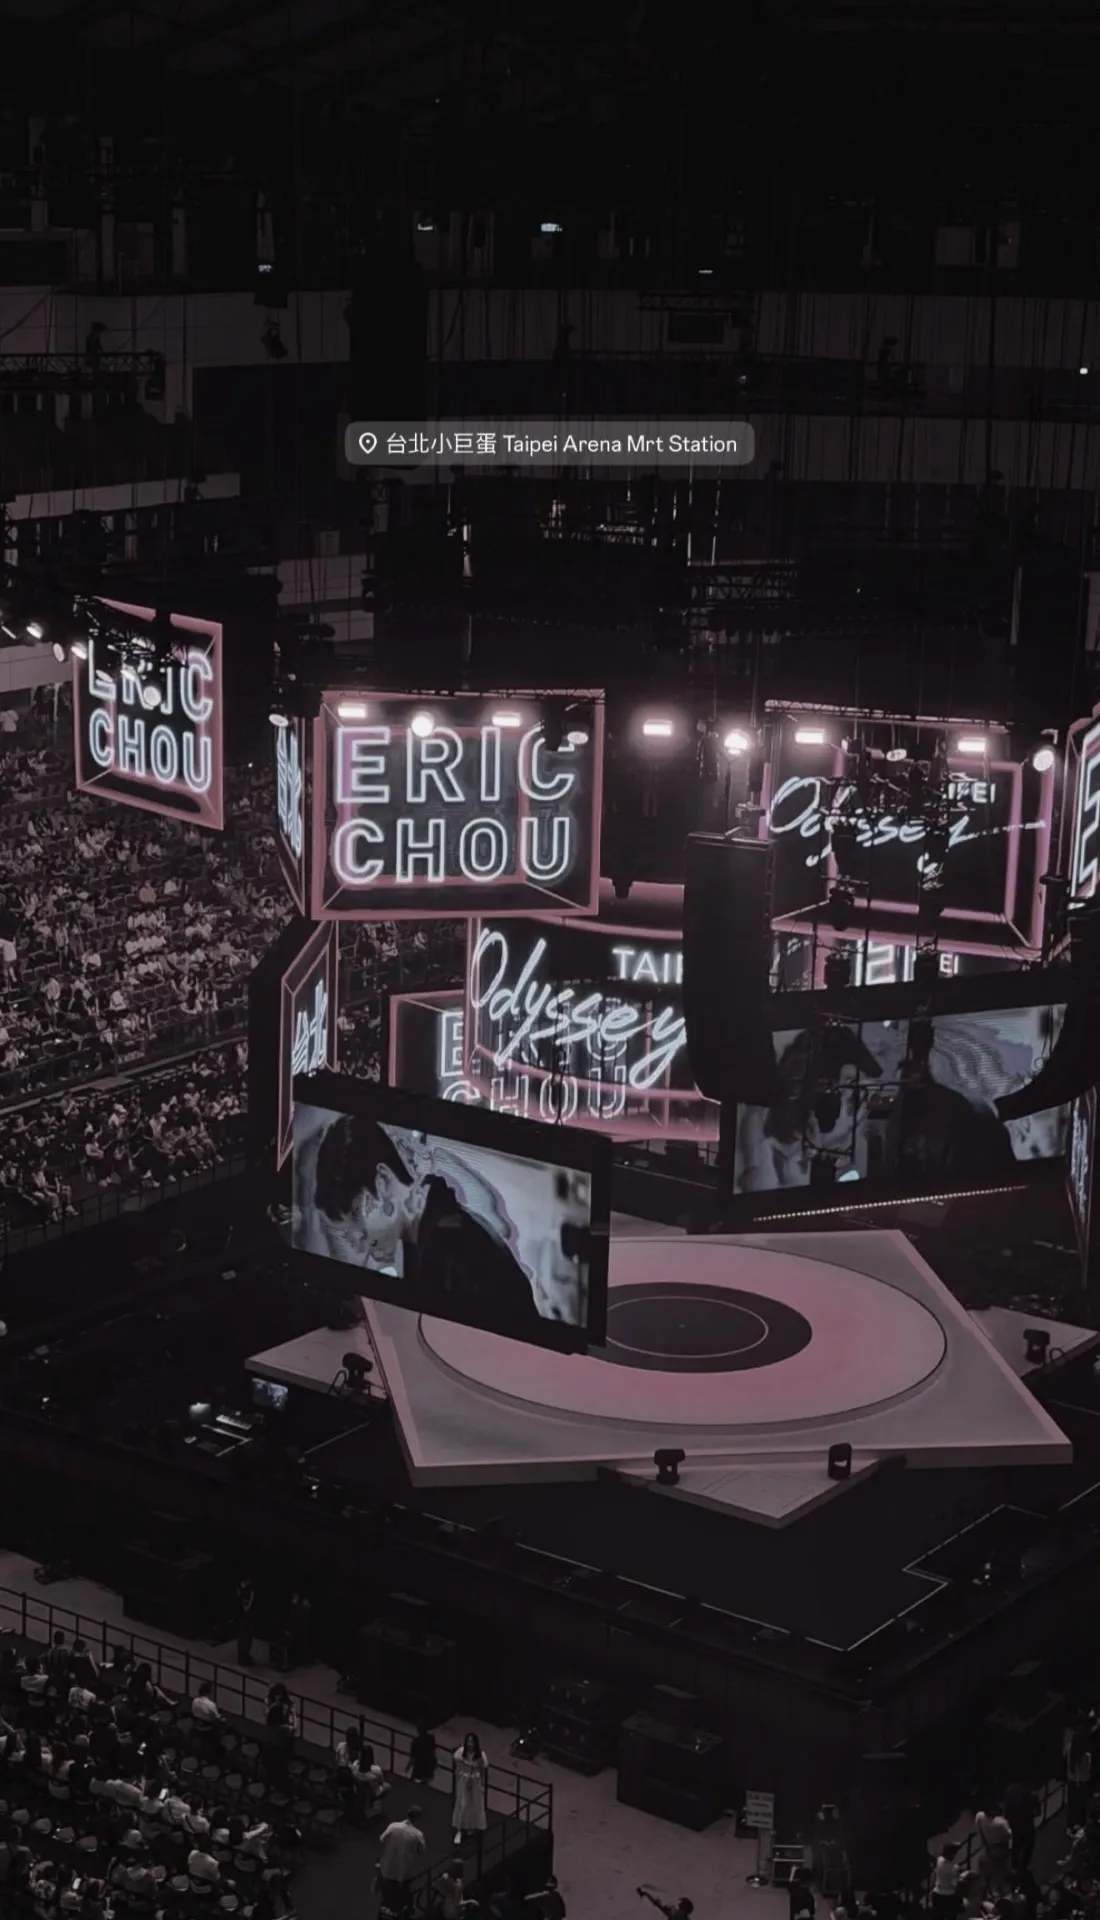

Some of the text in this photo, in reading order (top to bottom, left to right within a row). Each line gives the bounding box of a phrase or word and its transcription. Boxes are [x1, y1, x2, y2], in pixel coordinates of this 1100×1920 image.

[88, 708, 213, 793] CHOU
[334, 724, 576, 805] ERIC
[333, 816, 571, 883] CHOU
[470, 926, 688, 1090] Odyssey
